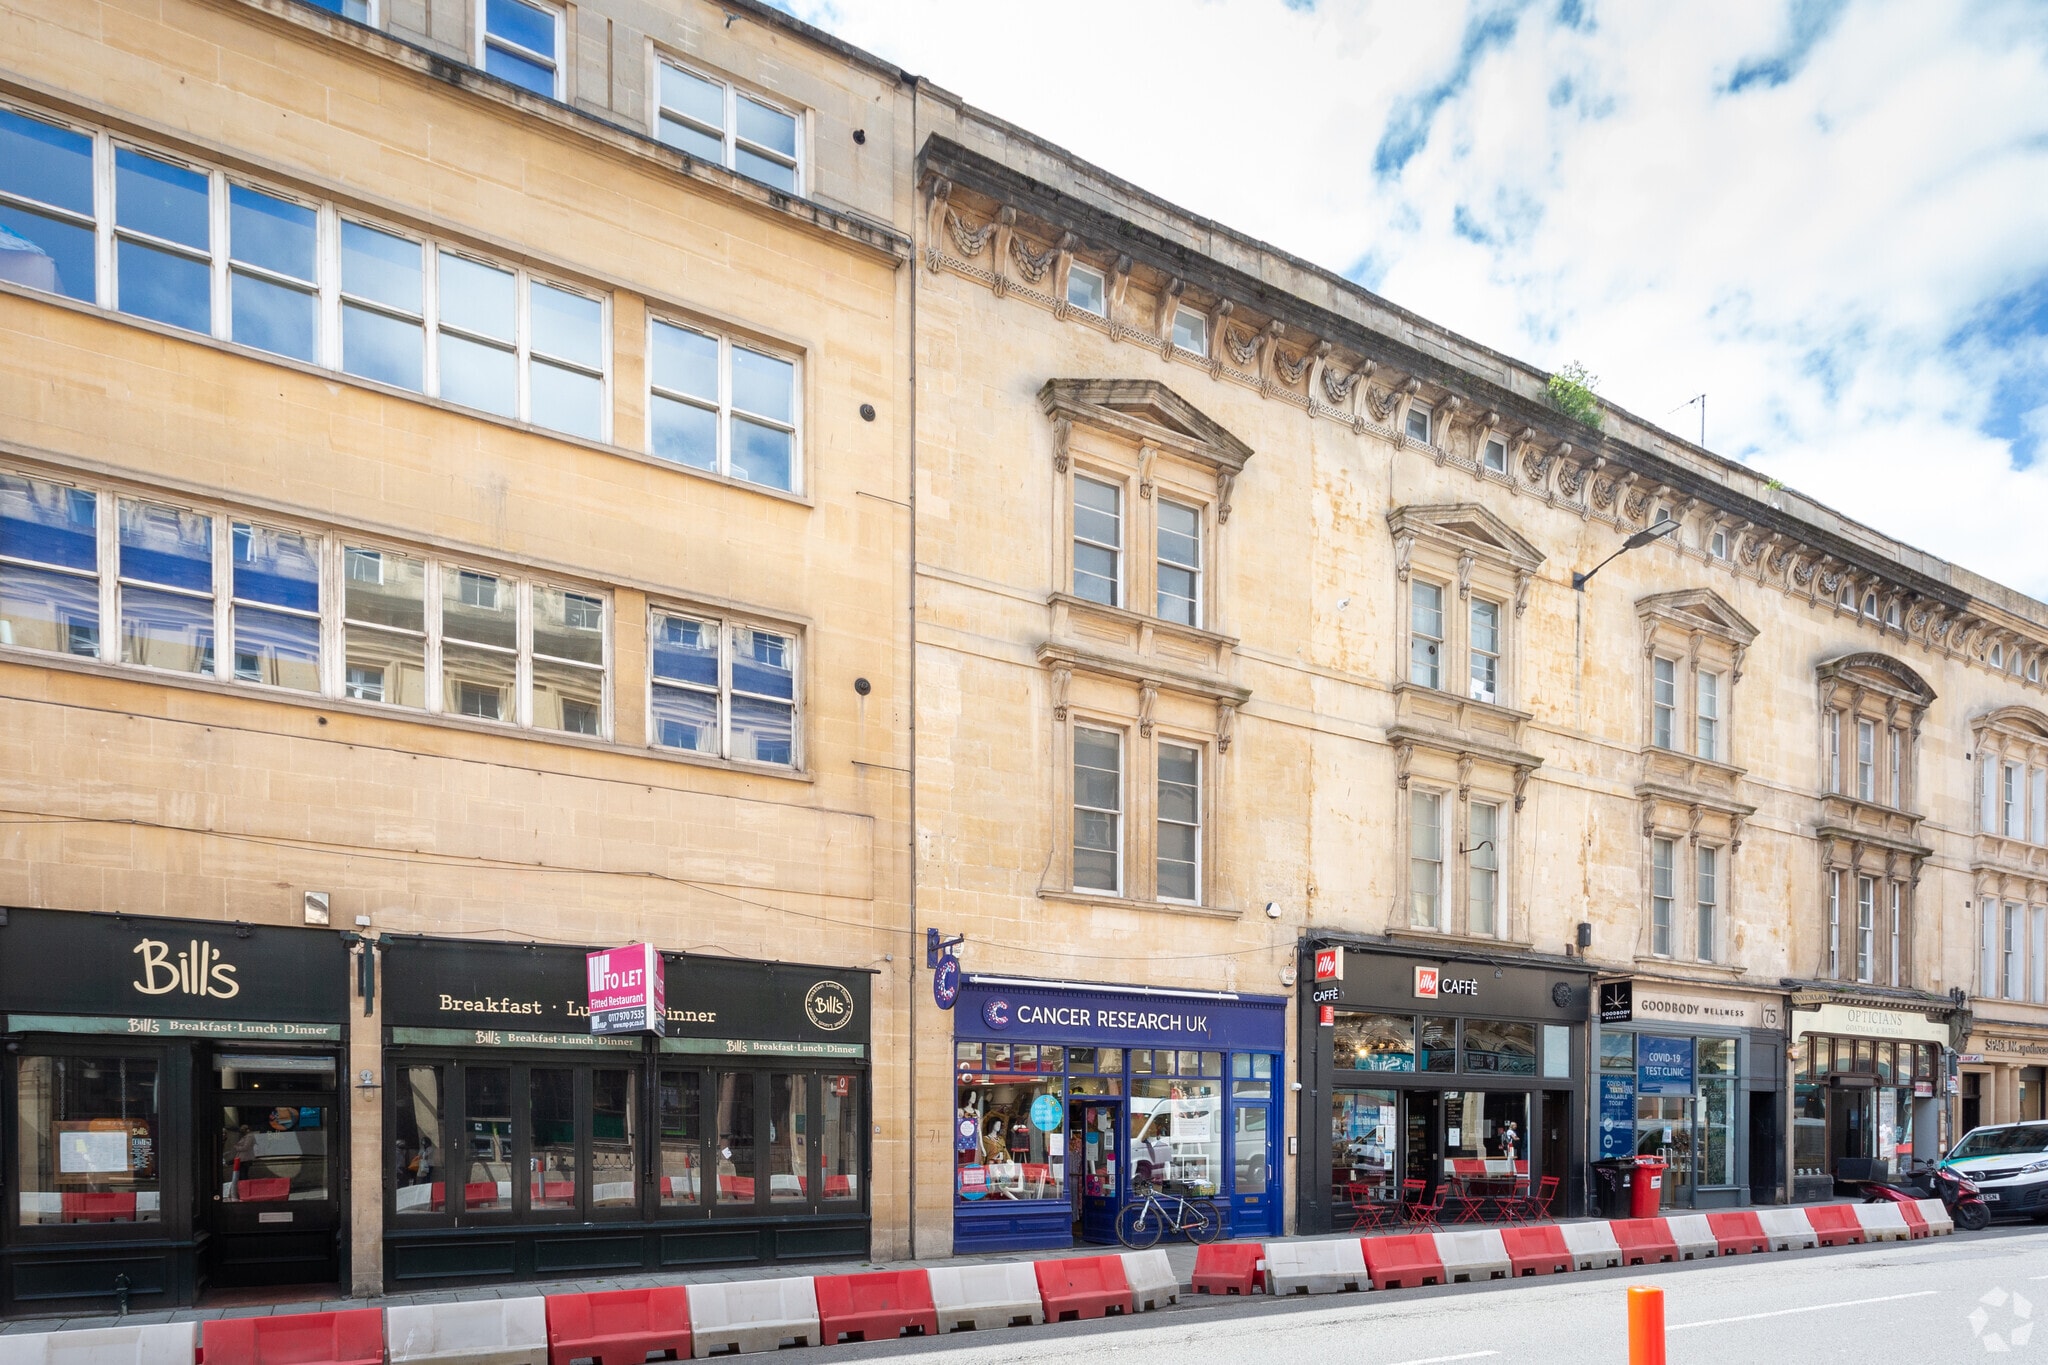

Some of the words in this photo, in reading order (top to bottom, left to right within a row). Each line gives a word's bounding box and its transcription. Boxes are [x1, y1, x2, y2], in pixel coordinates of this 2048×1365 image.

[133, 938, 239, 999] Bill's
[1318, 955, 1335, 975] illy
[604, 973, 619, 990] TO
[621, 968, 642, 987] LET
[1420, 974, 1436, 992] illy
[1442, 978, 1478, 996] CAFFÈ
[591, 998, 608, 1009] Fitted
[608, 993, 644, 1007] Restaurant
[1313, 987, 1339, 1002] CAFFÈ
[439, 994, 542, 1015] Breakfast
[814, 995, 844, 1014] Bill's
[1641, 1000, 1699, 1015] GOODBODY
[1704, 1007, 1744, 1017] WELLNESS
[619, 1011, 631, 1021] 970
[630, 1009, 645, 1020] 7535
[1017, 1005, 1090, 1027] CANCER
[1098, 1010, 1182, 1031] RESEARCH
[1186, 1016, 1207, 1032] UK
[1765, 1009, 1777, 1024] 75
[1847, 1009, 1902, 1026] OPTICIANS
[128, 1018, 159, 1033] Bill's
[170, 1020, 232, 1032] Breakfast
[238, 1023, 278, 1034] Lunch
[284, 1024, 328, 1035] Dinner
[475, 1030, 501, 1045] Bill's
[508, 1033, 558, 1044] Breakfast
[562, 1035, 593, 1045] Lunch
[598, 1037, 634, 1046] Dinner
[726, 1040, 747, 1053] Bill's
[753, 1043, 794, 1052] Breakfast
[797, 1044, 823, 1052] Lunch
[827, 1044, 856, 1054] Dinner
[1649, 1052, 1680, 1063] COVID-19
[1645, 1066, 1662, 1076] TEST
[1662, 1067, 1684, 1077] CLINIC
[929, 1129, 940, 1143] 71
